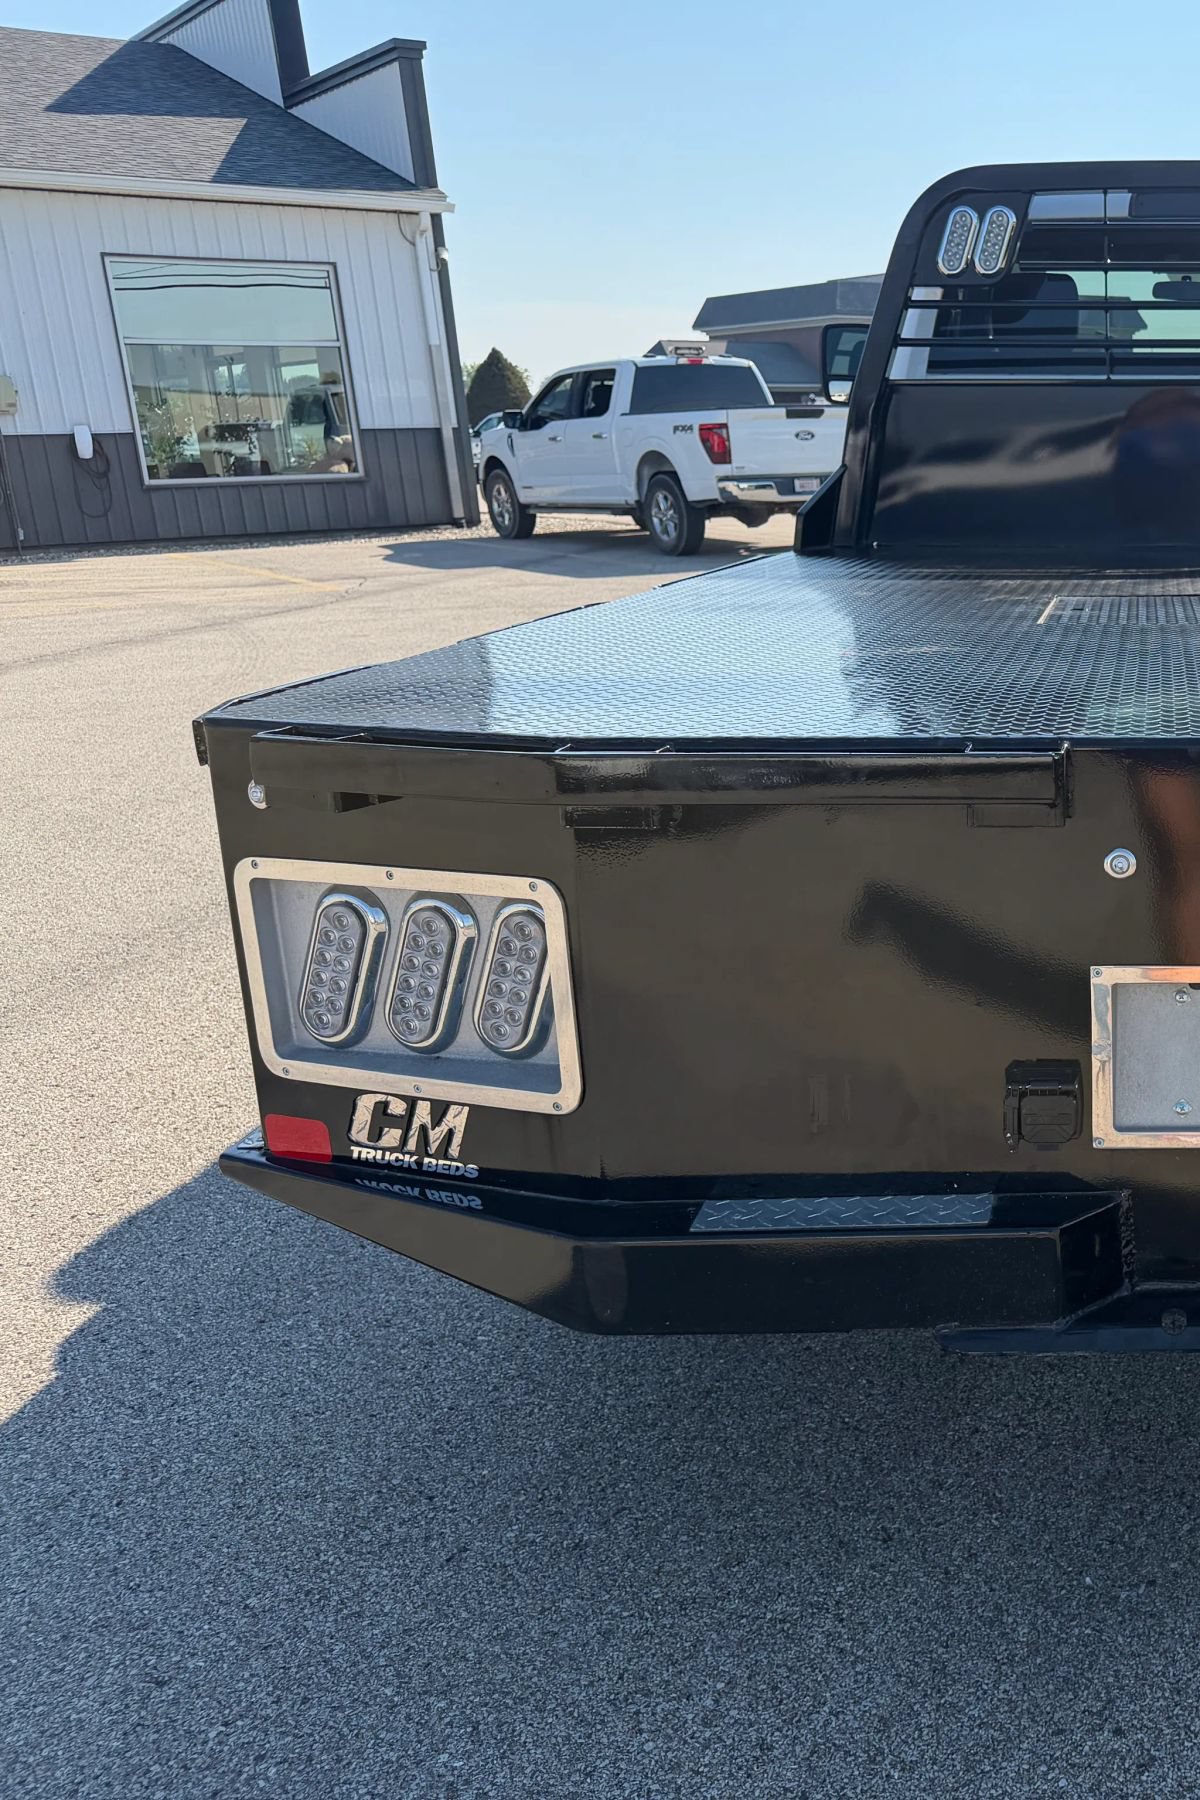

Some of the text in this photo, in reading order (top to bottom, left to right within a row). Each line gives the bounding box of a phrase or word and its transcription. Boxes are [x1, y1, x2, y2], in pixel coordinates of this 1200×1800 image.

[349, 1093, 470, 1160] CM
[350, 1146, 480, 1178] TRUCK BEDS
